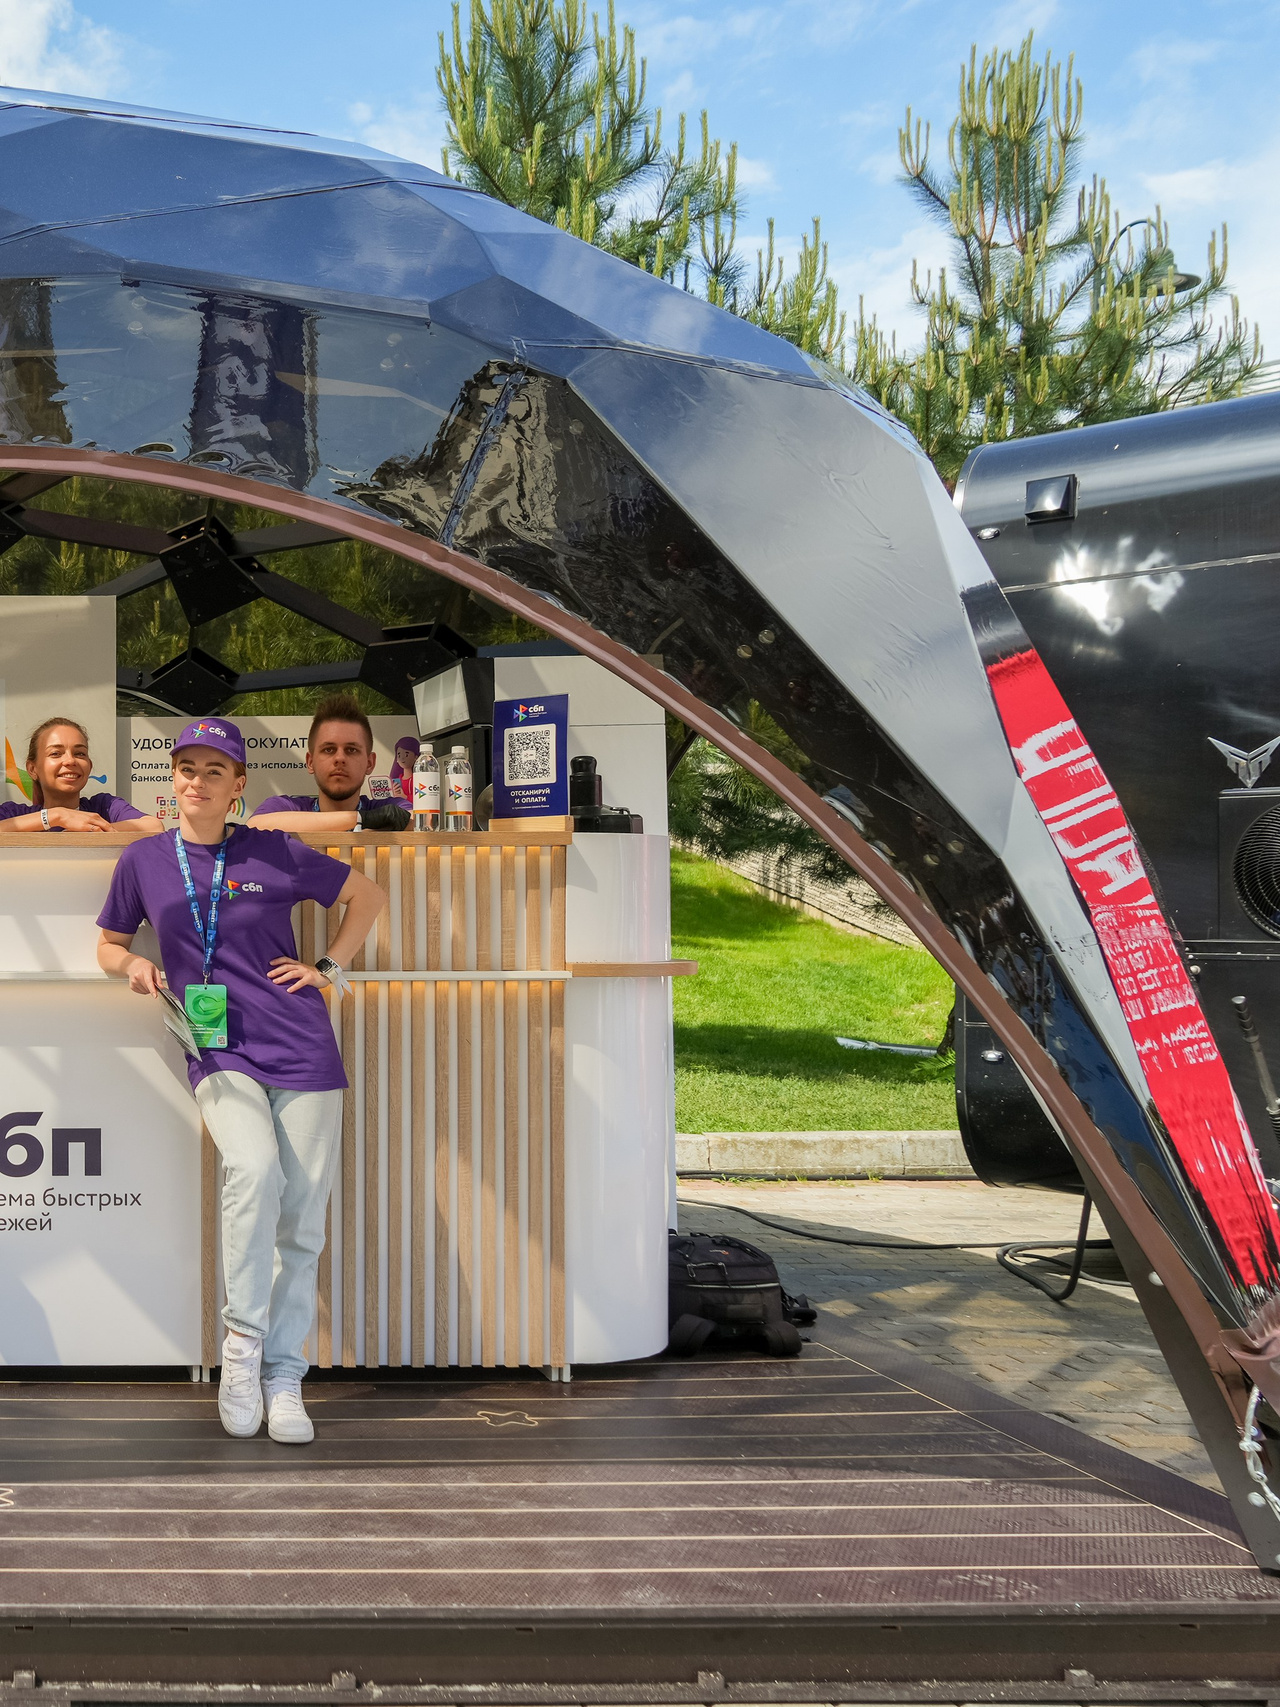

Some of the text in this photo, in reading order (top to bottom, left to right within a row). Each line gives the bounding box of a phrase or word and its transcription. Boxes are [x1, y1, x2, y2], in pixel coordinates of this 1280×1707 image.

[528, 704, 544, 713] сбп
[208, 726, 227, 738] сбп
[132, 738, 176, 750] УДОБ
[131, 761, 170, 770] Оплата
[510, 787, 550, 796] ОТСКАНИРУЙ
[521, 796, 546, 804] ОПЛАТИ
[242, 882, 263, 893] сбп
[42, 1188, 142, 1211] быстрых
